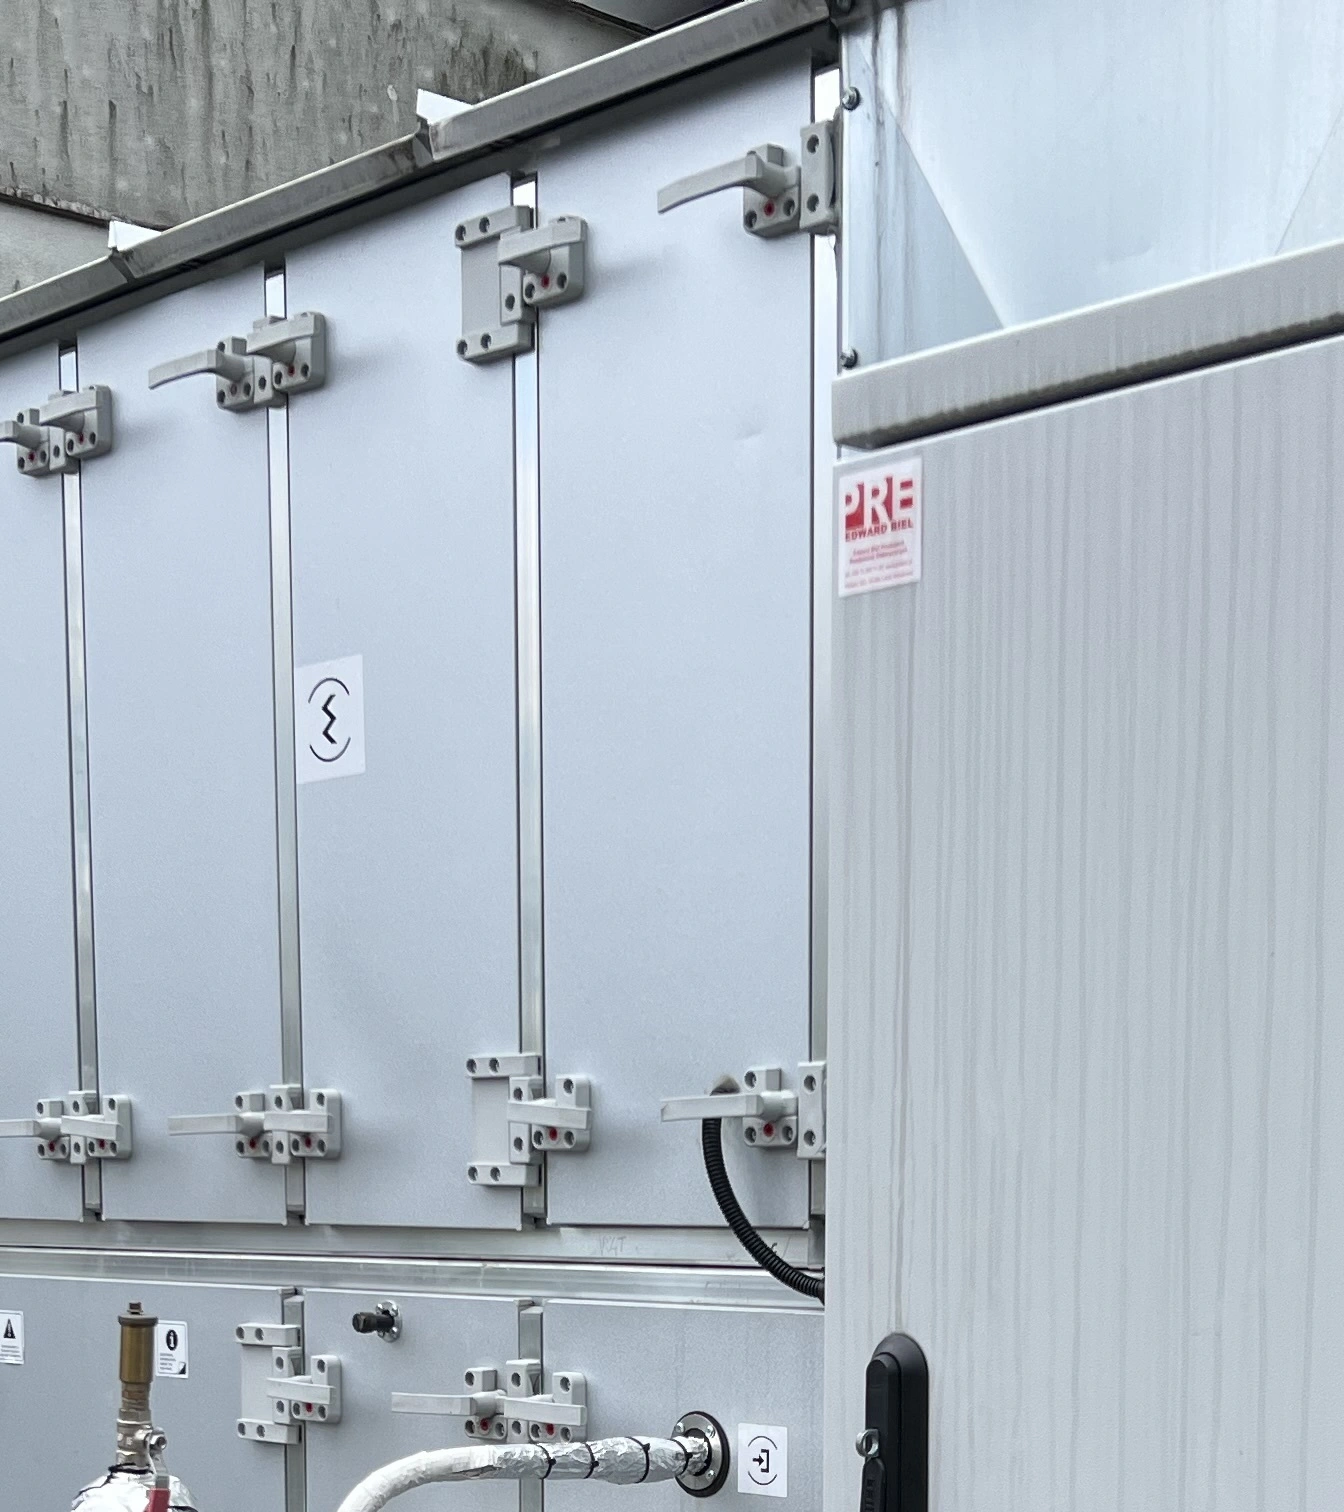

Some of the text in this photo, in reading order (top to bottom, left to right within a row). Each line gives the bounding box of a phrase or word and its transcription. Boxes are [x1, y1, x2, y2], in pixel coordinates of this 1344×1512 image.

[845, 473, 914, 531] PRE
[845, 517, 914, 542] EDWARD BIEL
